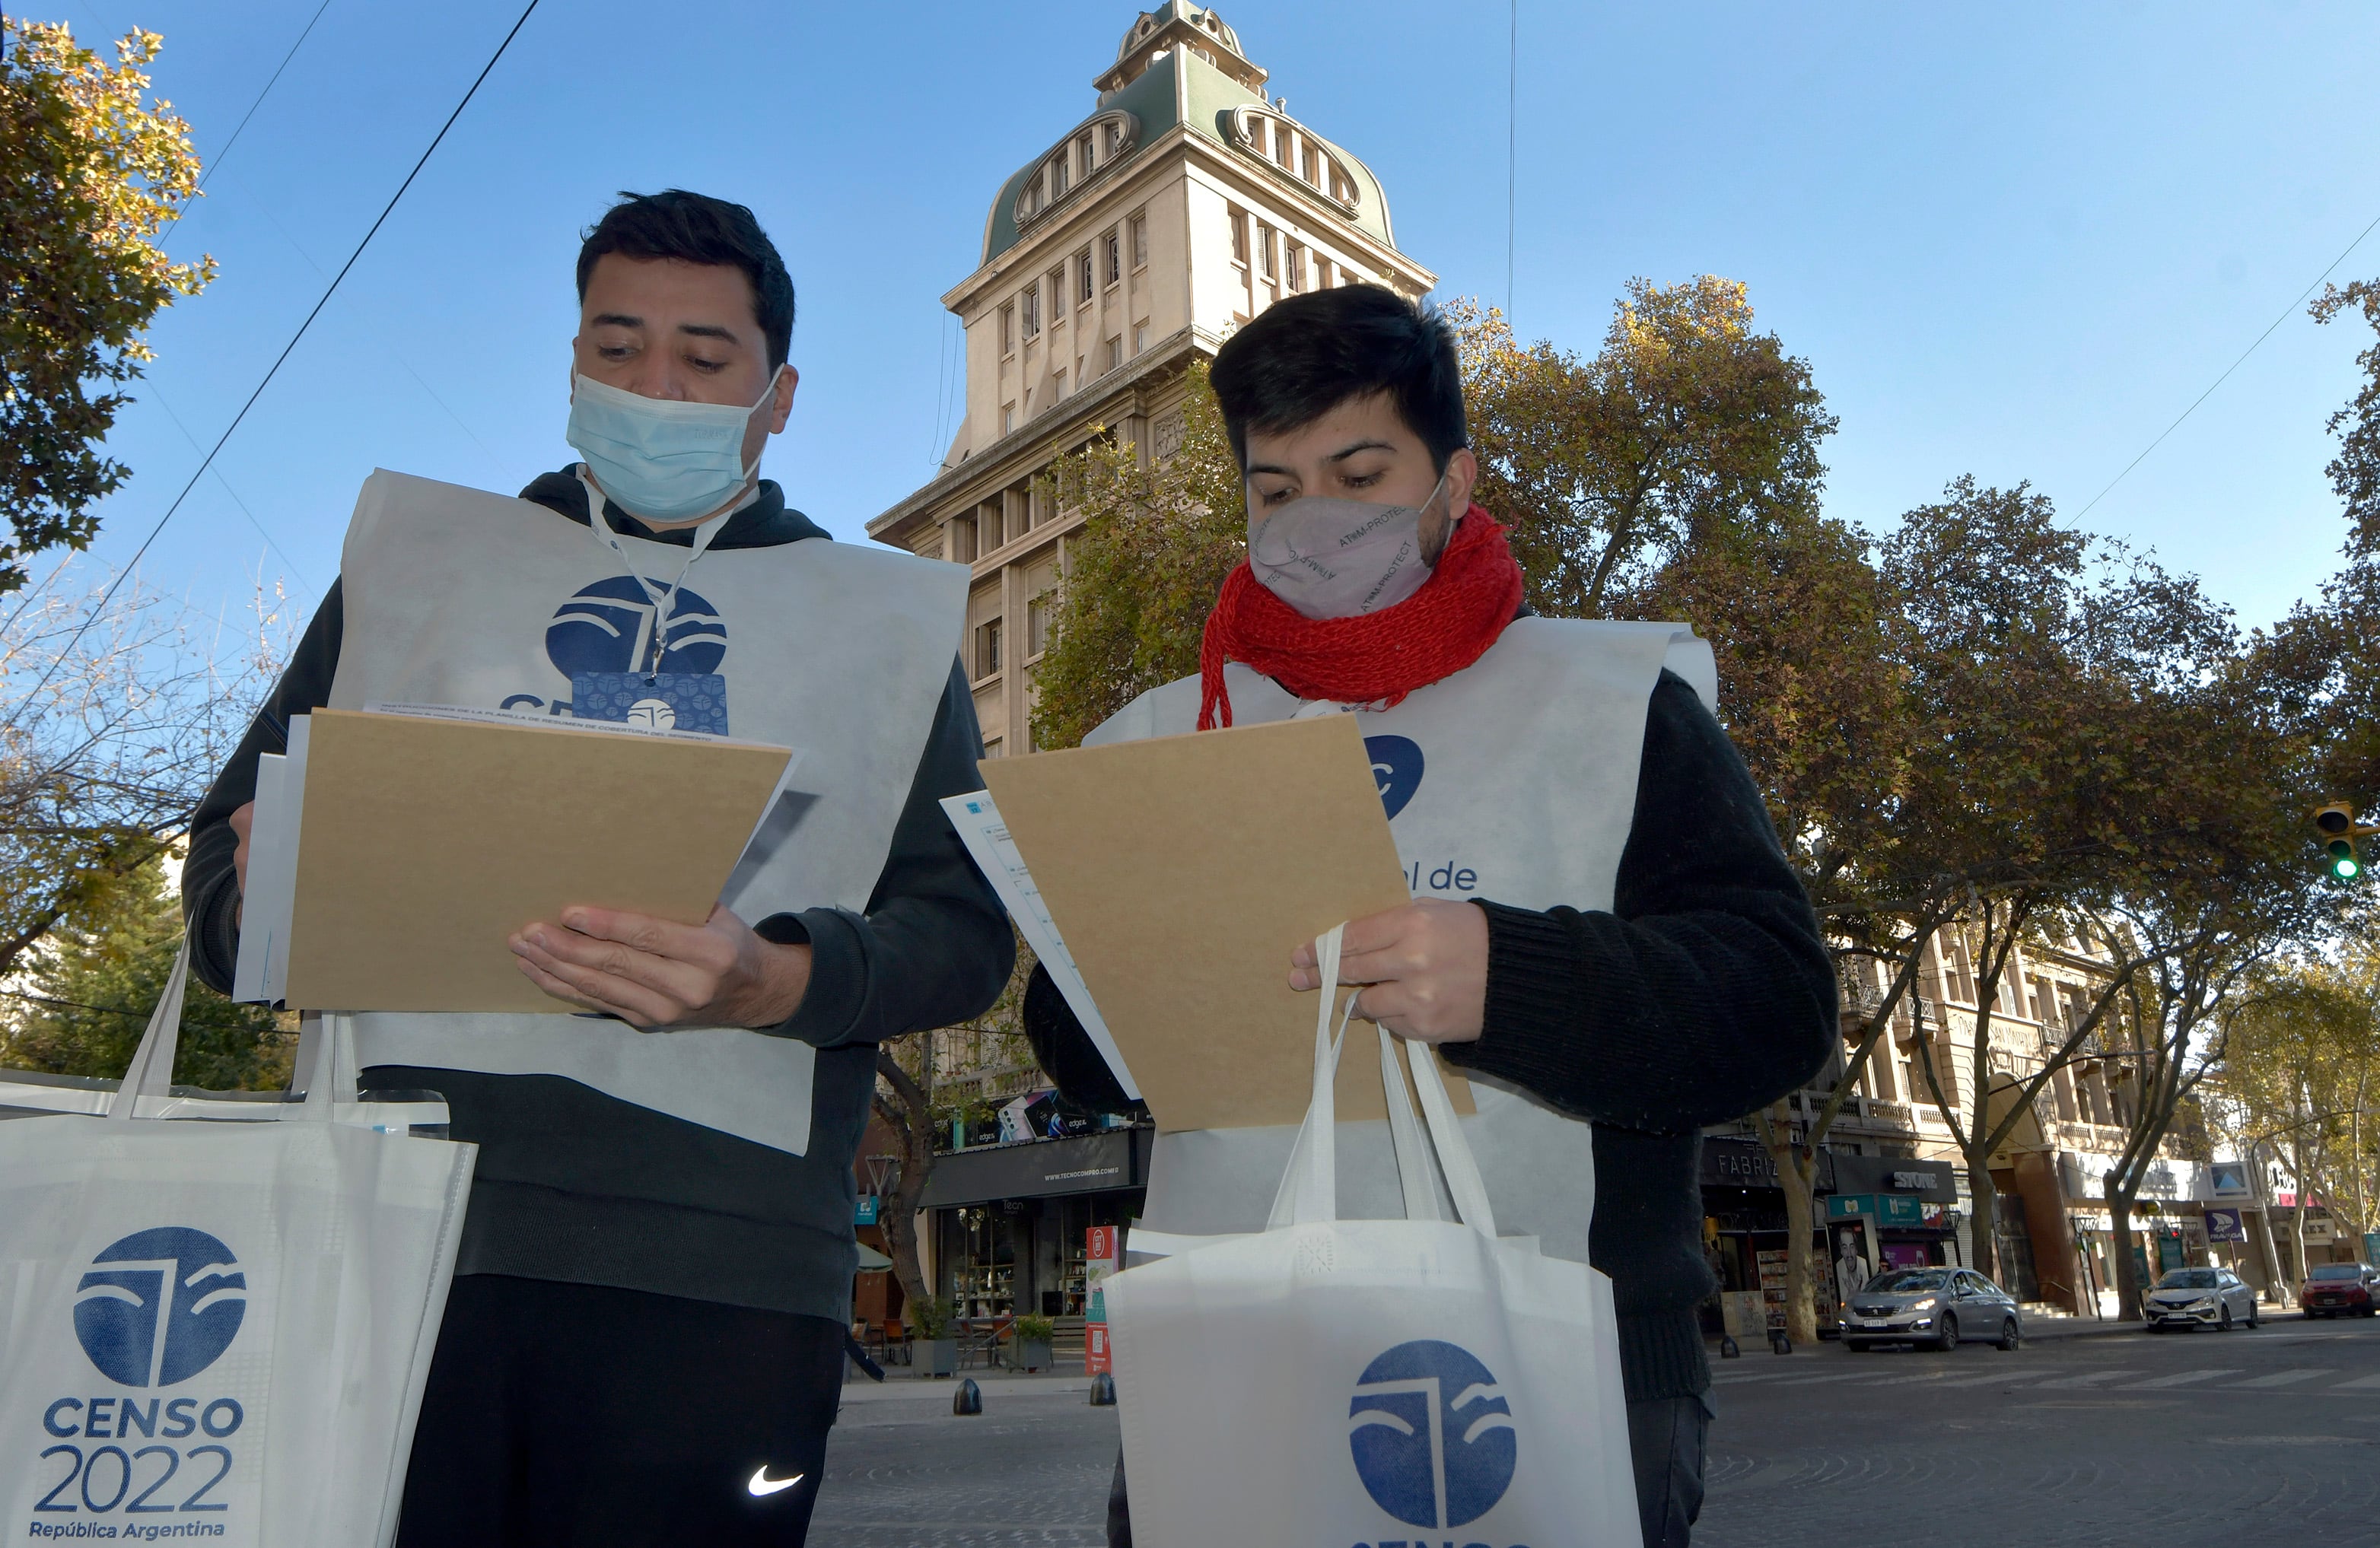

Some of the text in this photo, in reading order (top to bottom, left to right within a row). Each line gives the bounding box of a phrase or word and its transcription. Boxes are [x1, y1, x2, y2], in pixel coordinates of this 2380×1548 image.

[485, 710, 526, 721] PLANILLA
[542, 717, 584, 729] RESUMEN
[598, 725, 648, 736] COBERTURA
[1430, 861, 1478, 890] de
[1958, 1015, 2032, 1047] PAS SAN MARTIN
[1894, 1171, 1938, 1189] STONE
[43, 1397, 243, 1438] CENSO
[33, 1445, 232, 1513] 2022
[29, 1520, 225, 1541] República Argentina
